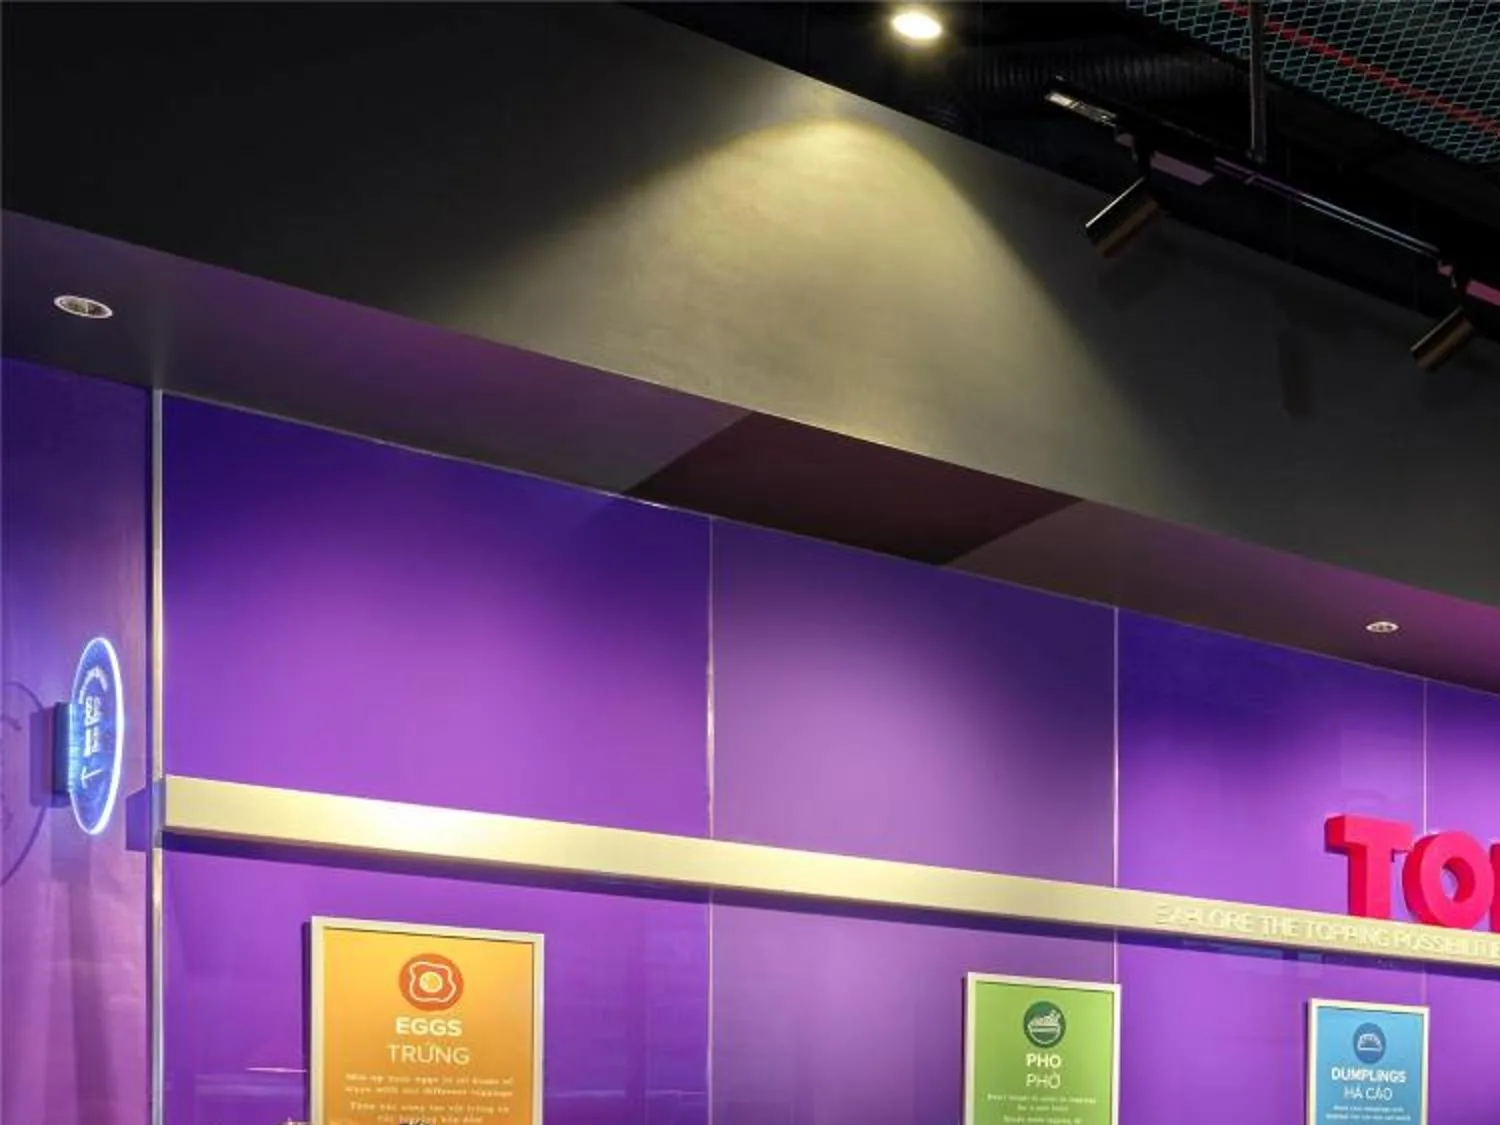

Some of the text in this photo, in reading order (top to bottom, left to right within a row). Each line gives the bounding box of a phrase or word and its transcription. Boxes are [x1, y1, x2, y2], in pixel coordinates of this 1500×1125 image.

[1262, 914, 1302, 940] THE
[395, 1016, 463, 1037] EGGS
[1026, 1052, 1062, 1069] PHO
[1331, 1066, 1407, 1084] DUMPLINGS
